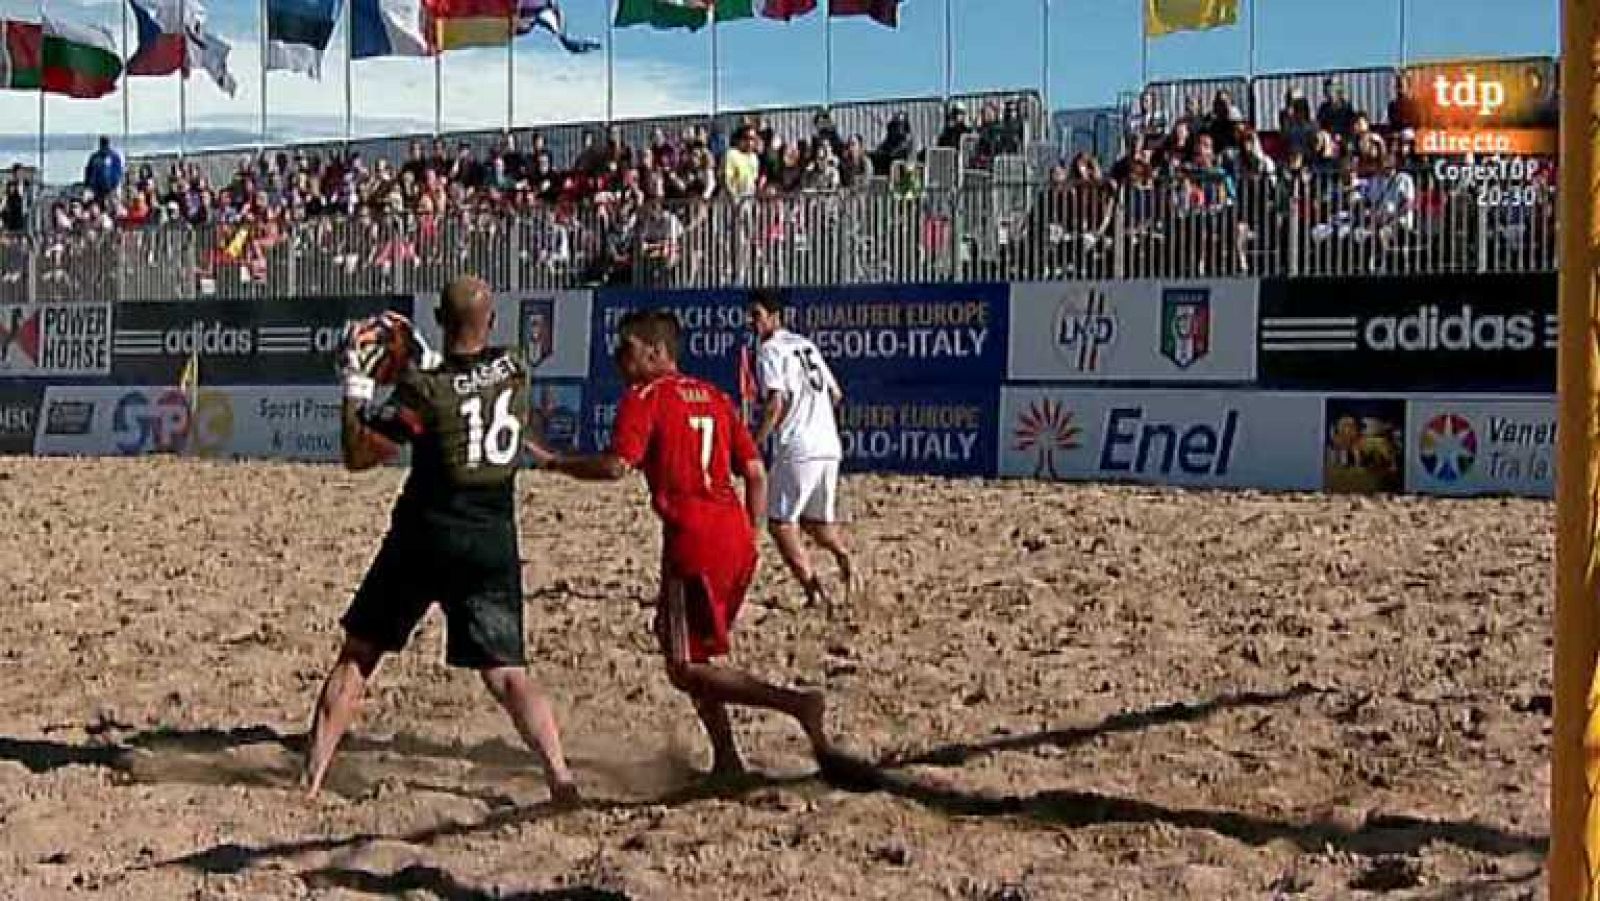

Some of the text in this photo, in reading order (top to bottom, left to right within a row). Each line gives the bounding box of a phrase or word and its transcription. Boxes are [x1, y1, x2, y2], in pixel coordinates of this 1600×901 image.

[45, 308, 108, 335] POWER
[806, 303, 899, 329] QUALIFIER
[907, 301, 991, 326] EUROPE
[1364, 303, 1536, 351] adidas
[43, 339, 108, 369] HORSE
[165, 318, 252, 355] adidas
[690, 332, 734, 358] CUP
[793, 347, 825, 393] 15
[460, 388, 520, 469] 16
[688, 416, 715, 473] 7
[1099, 405, 1241, 478] Enel
